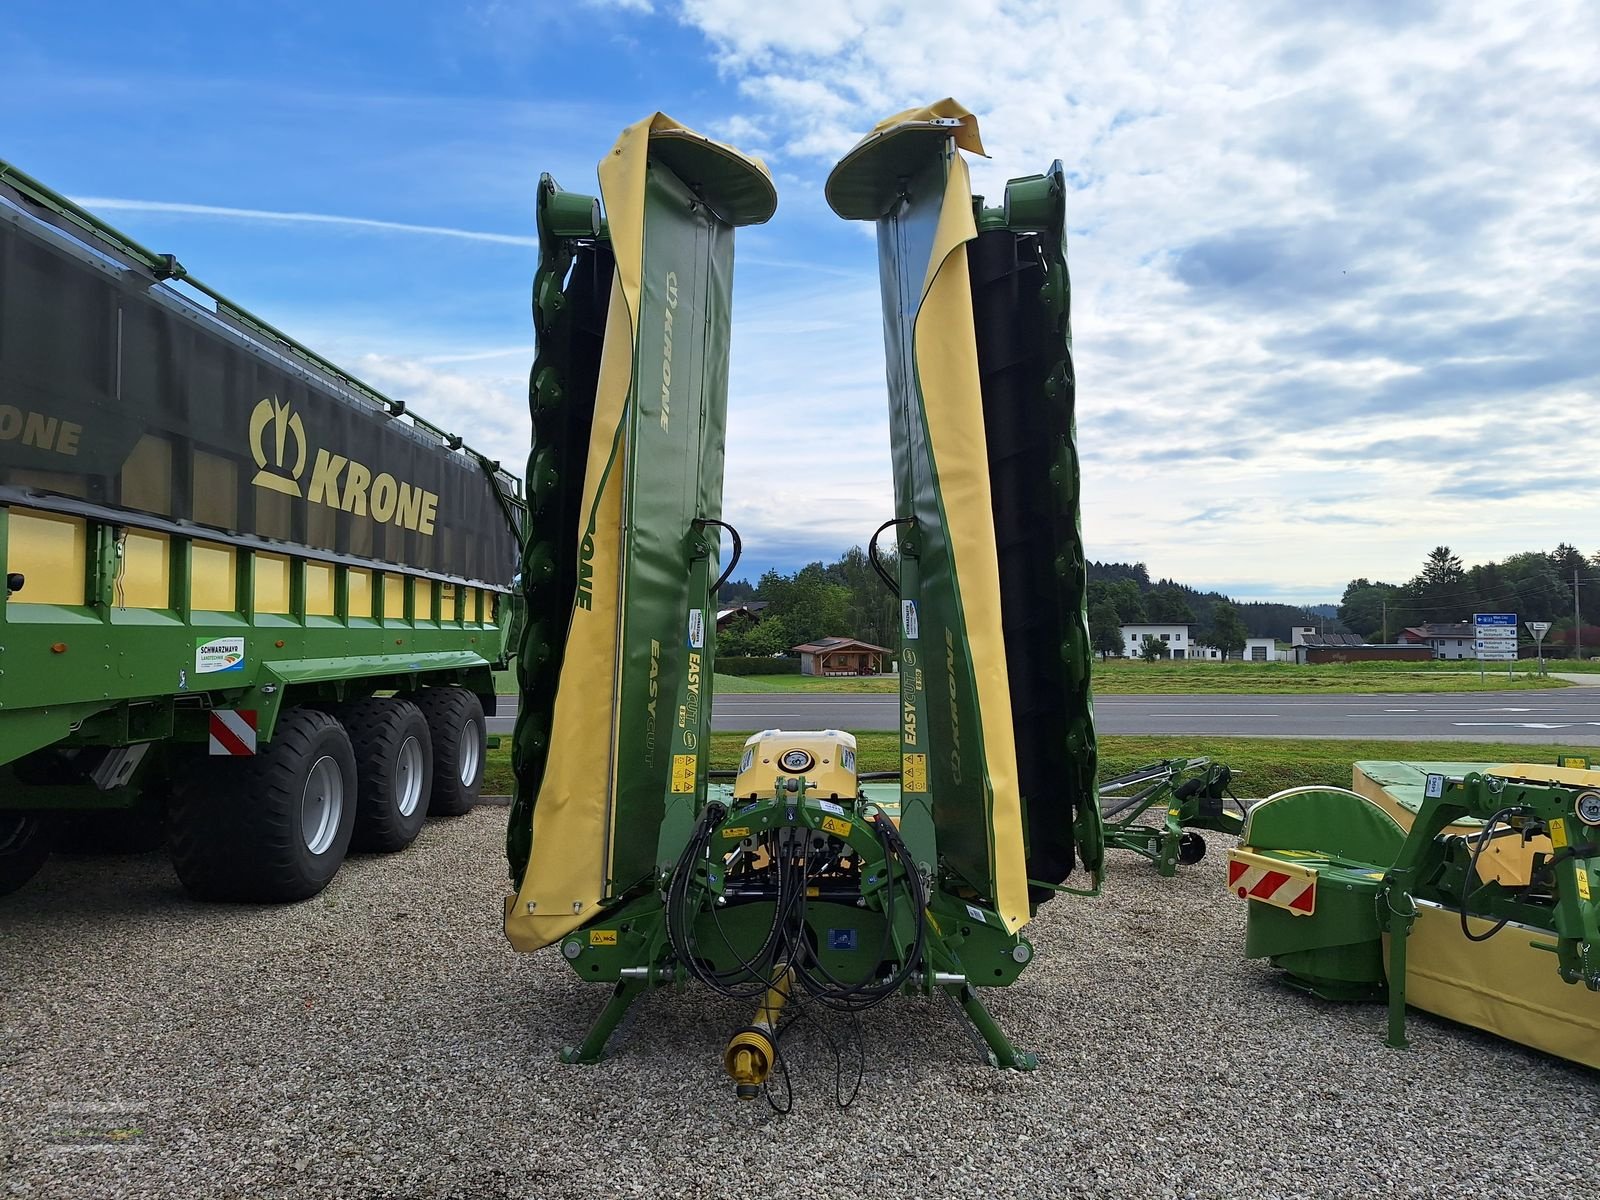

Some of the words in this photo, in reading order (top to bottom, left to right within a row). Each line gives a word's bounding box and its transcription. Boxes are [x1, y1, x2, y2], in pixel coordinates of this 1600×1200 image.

[660, 307, 673, 434] KRONE
[0, 404, 83, 456] ONE
[308, 448, 438, 535] KRONE
[576, 514, 596, 611] ONE
[686, 653, 700, 725] EASYCUT
[904, 671, 917, 746] EASYCUT
[945, 626, 959, 750] KRONE
